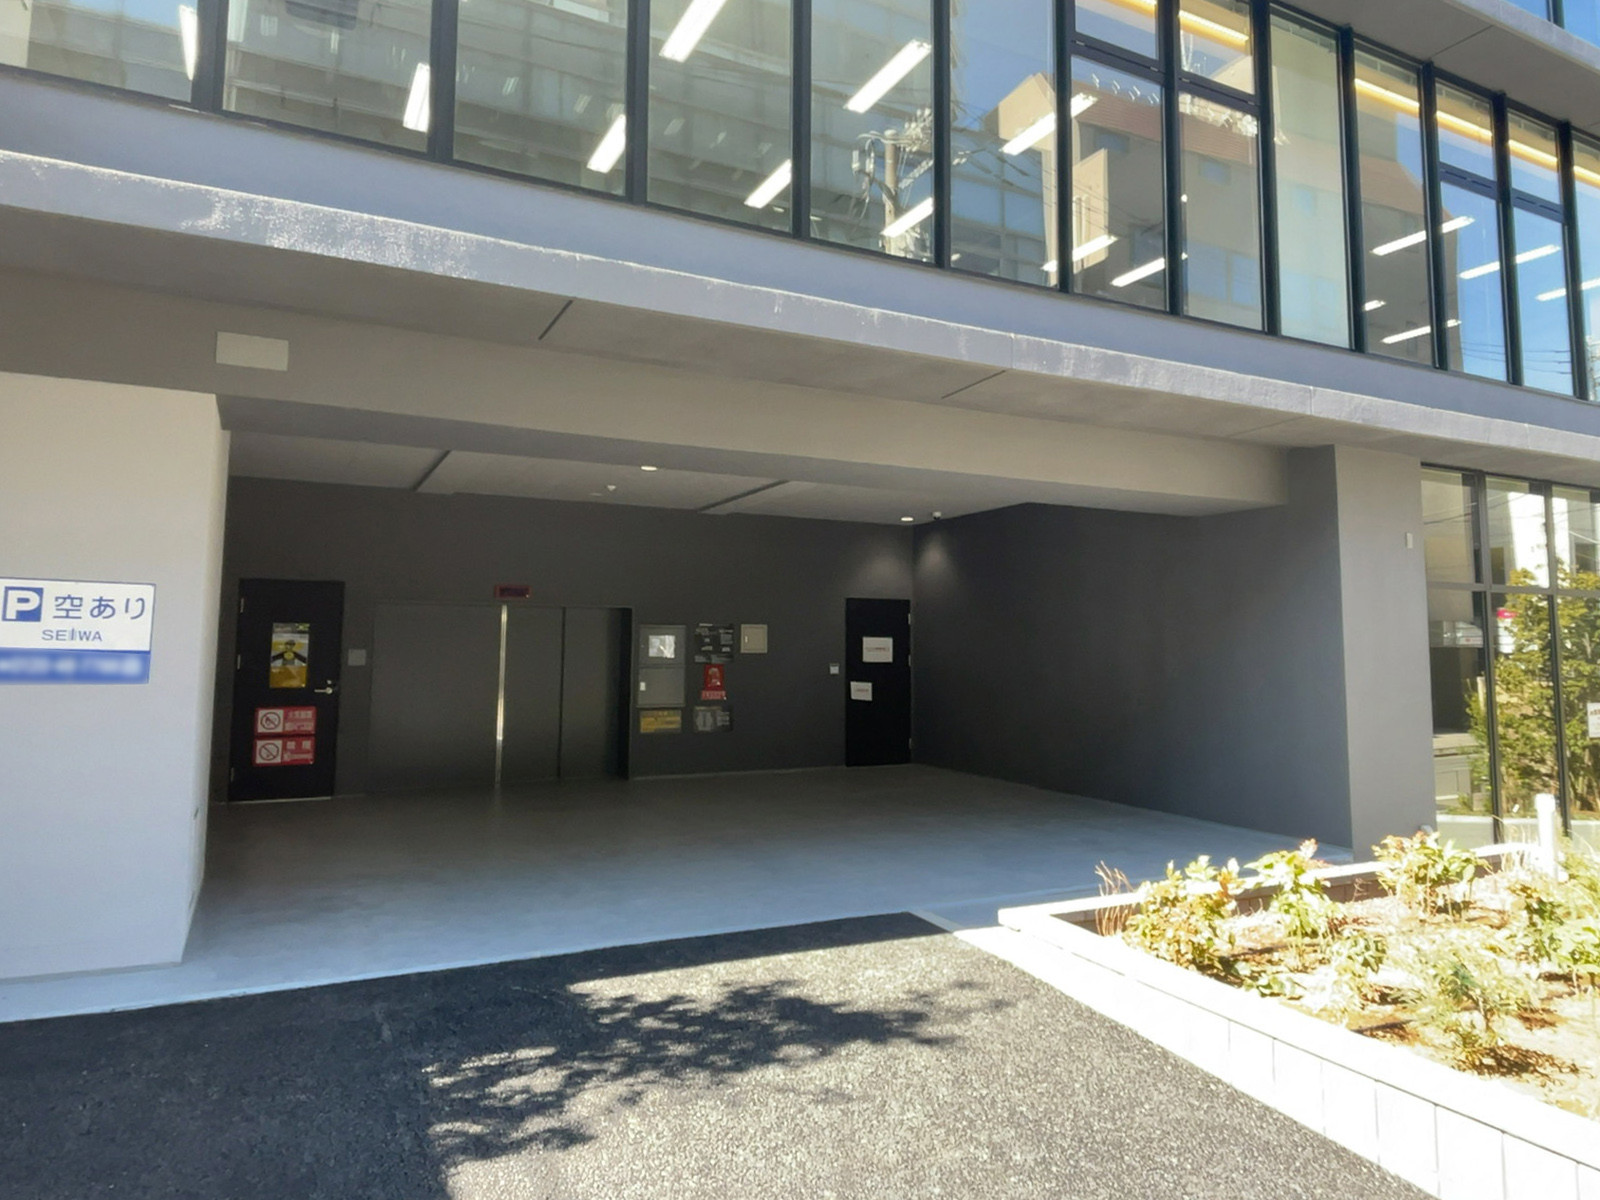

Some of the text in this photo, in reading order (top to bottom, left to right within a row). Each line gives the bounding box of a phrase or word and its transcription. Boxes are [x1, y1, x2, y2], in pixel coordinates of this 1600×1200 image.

[5, 589, 146, 620] P 空あり
[41, 627, 103, 642] SEIWA
